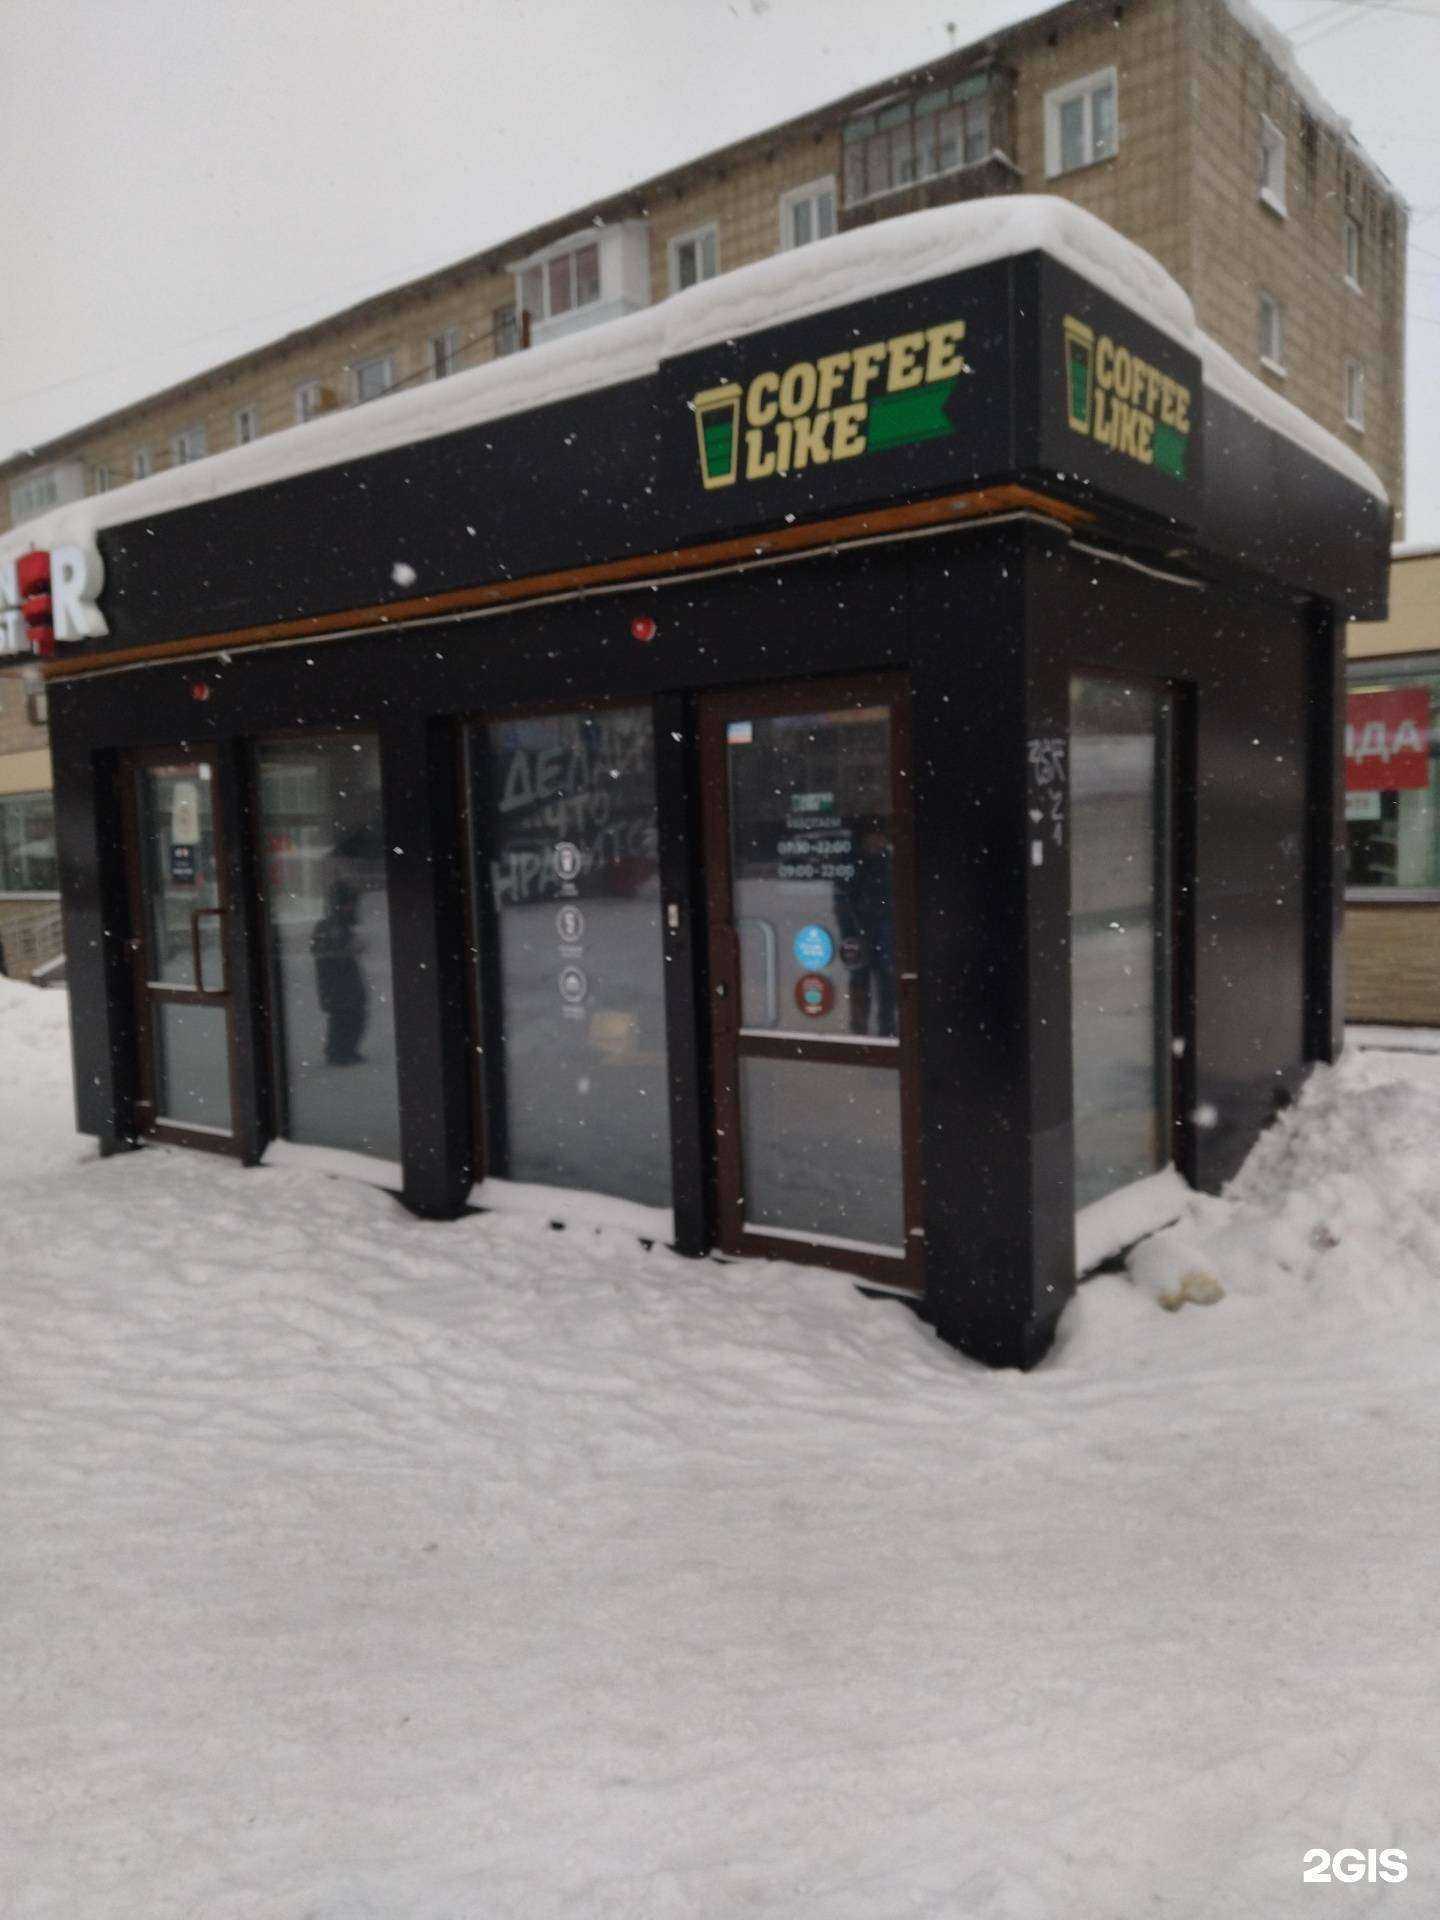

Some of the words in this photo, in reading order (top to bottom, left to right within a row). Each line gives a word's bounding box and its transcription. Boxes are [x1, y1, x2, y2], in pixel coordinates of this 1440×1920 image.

[746, 320, 966, 426] COFFEE
[1095, 336, 1191, 434] COFFEE
[745, 402, 868, 480] LIKE
[1093, 389, 1155, 465] LIKE
